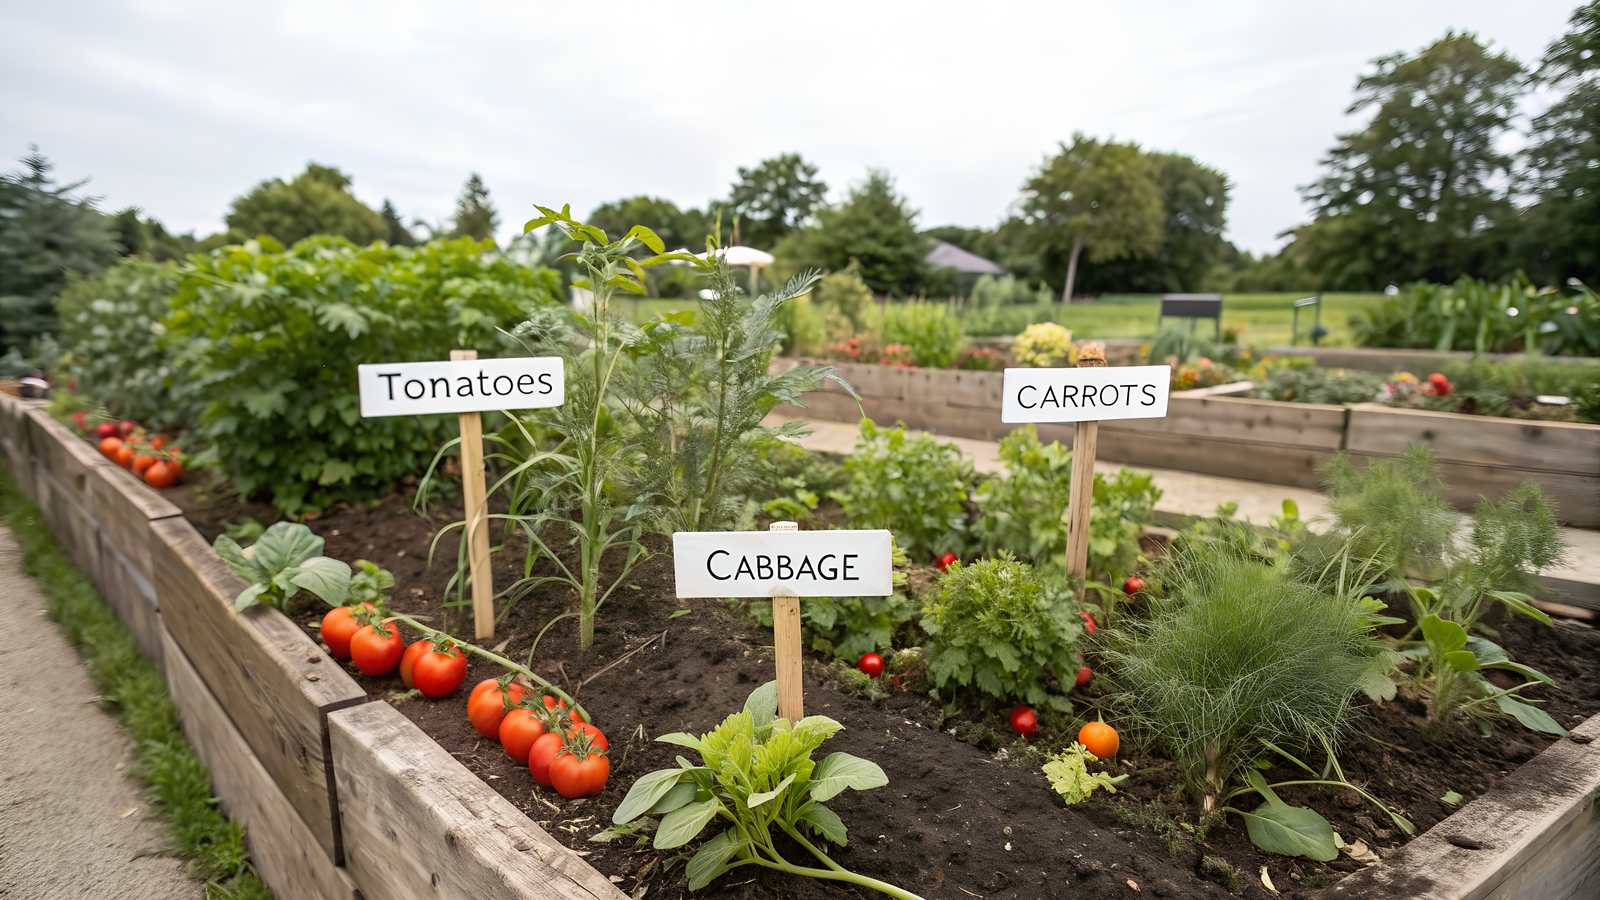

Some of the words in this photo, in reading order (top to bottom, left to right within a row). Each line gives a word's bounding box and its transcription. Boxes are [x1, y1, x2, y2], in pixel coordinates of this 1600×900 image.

[377, 369, 553, 401] Tonatoes
[1017, 384, 1156, 409] CARROTS
[706, 549, 860, 581] CABBAGE
